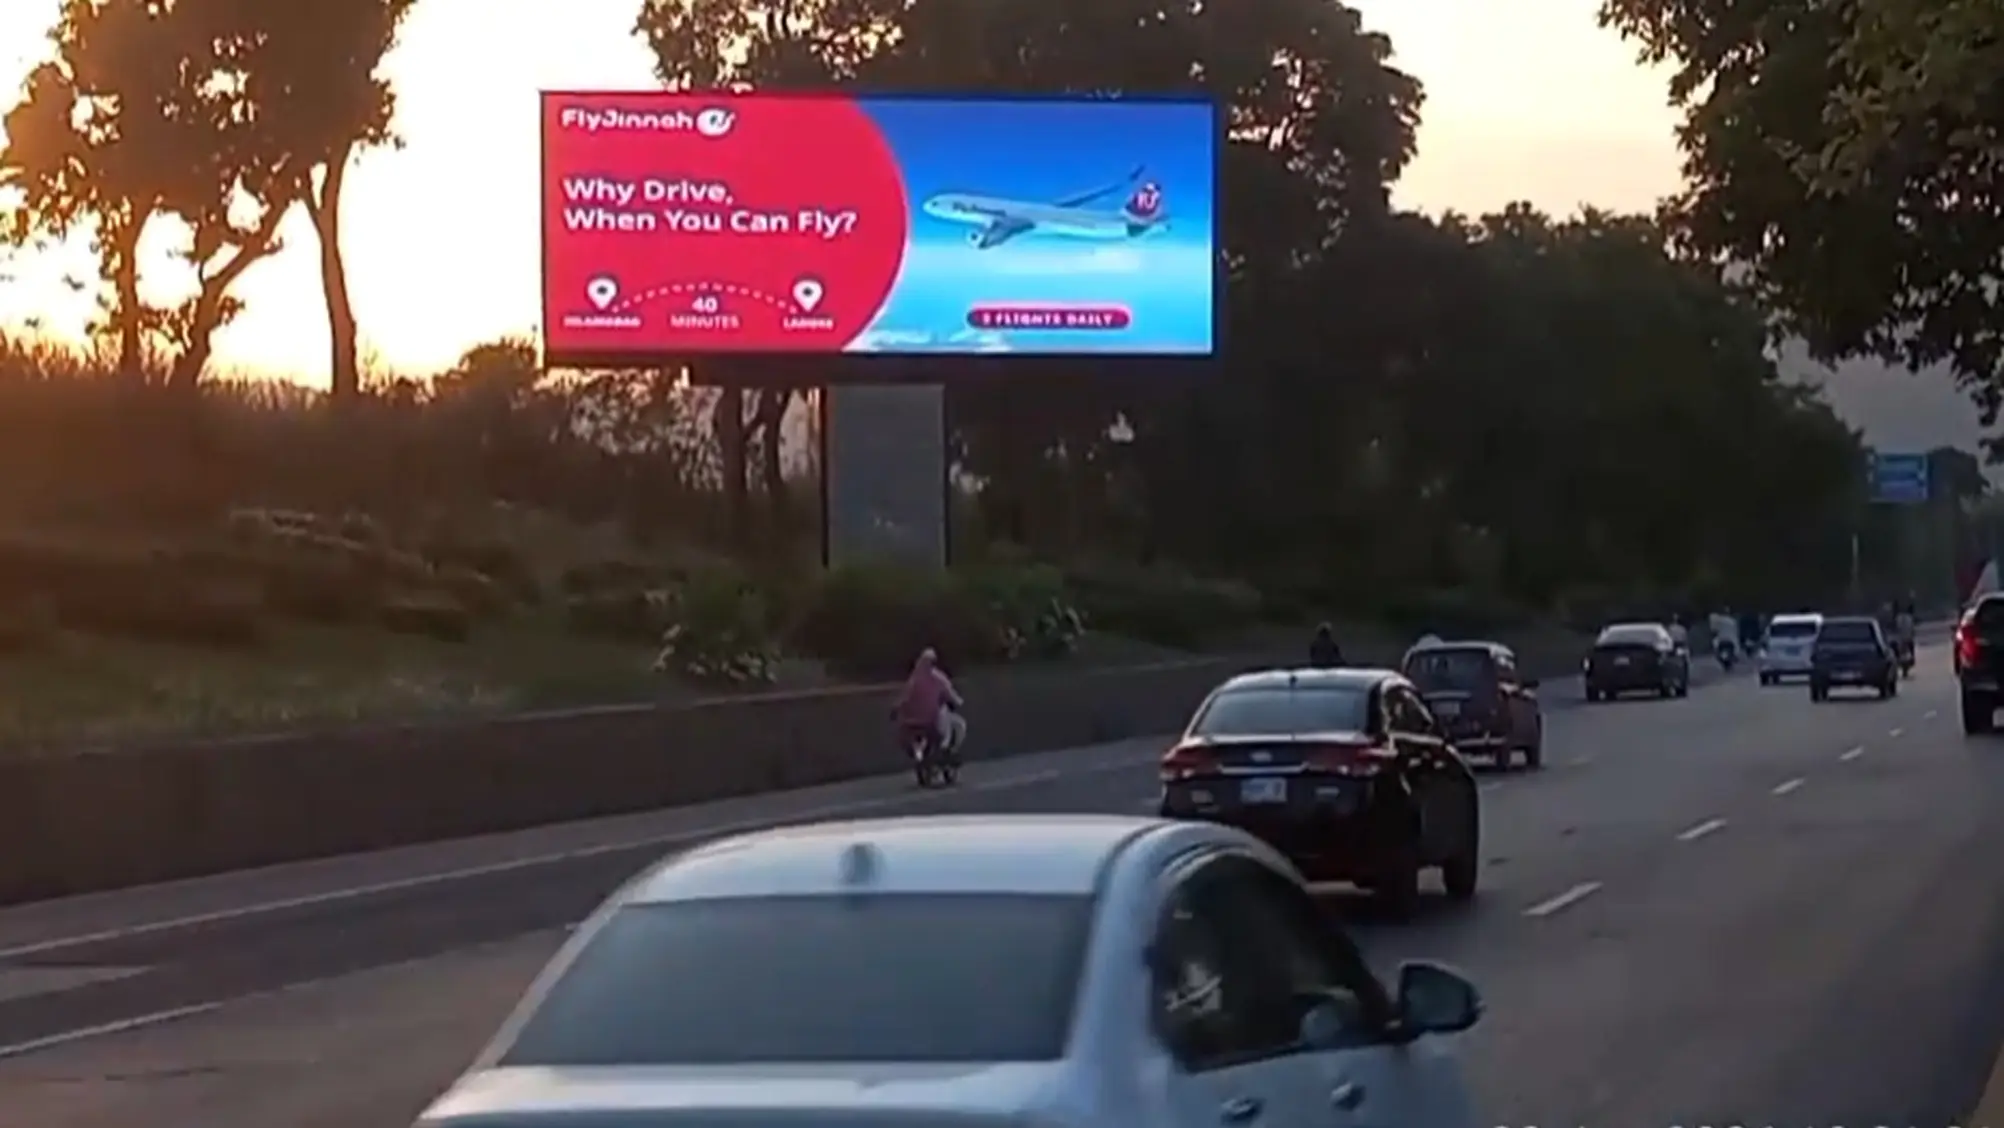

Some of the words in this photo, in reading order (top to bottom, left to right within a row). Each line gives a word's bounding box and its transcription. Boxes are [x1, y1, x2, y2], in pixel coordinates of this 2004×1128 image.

[562, 108, 693, 131] FlyJinnah
[563, 178, 635, 205] Why
[643, 179, 734, 205] Drive,
[563, 208, 656, 231] When
[664, 209, 722, 231] You
[730, 210, 789, 232] Can
[798, 210, 857, 238] Fly?
[692, 296, 718, 313] 40
[670, 315, 740, 328] MINUTES
